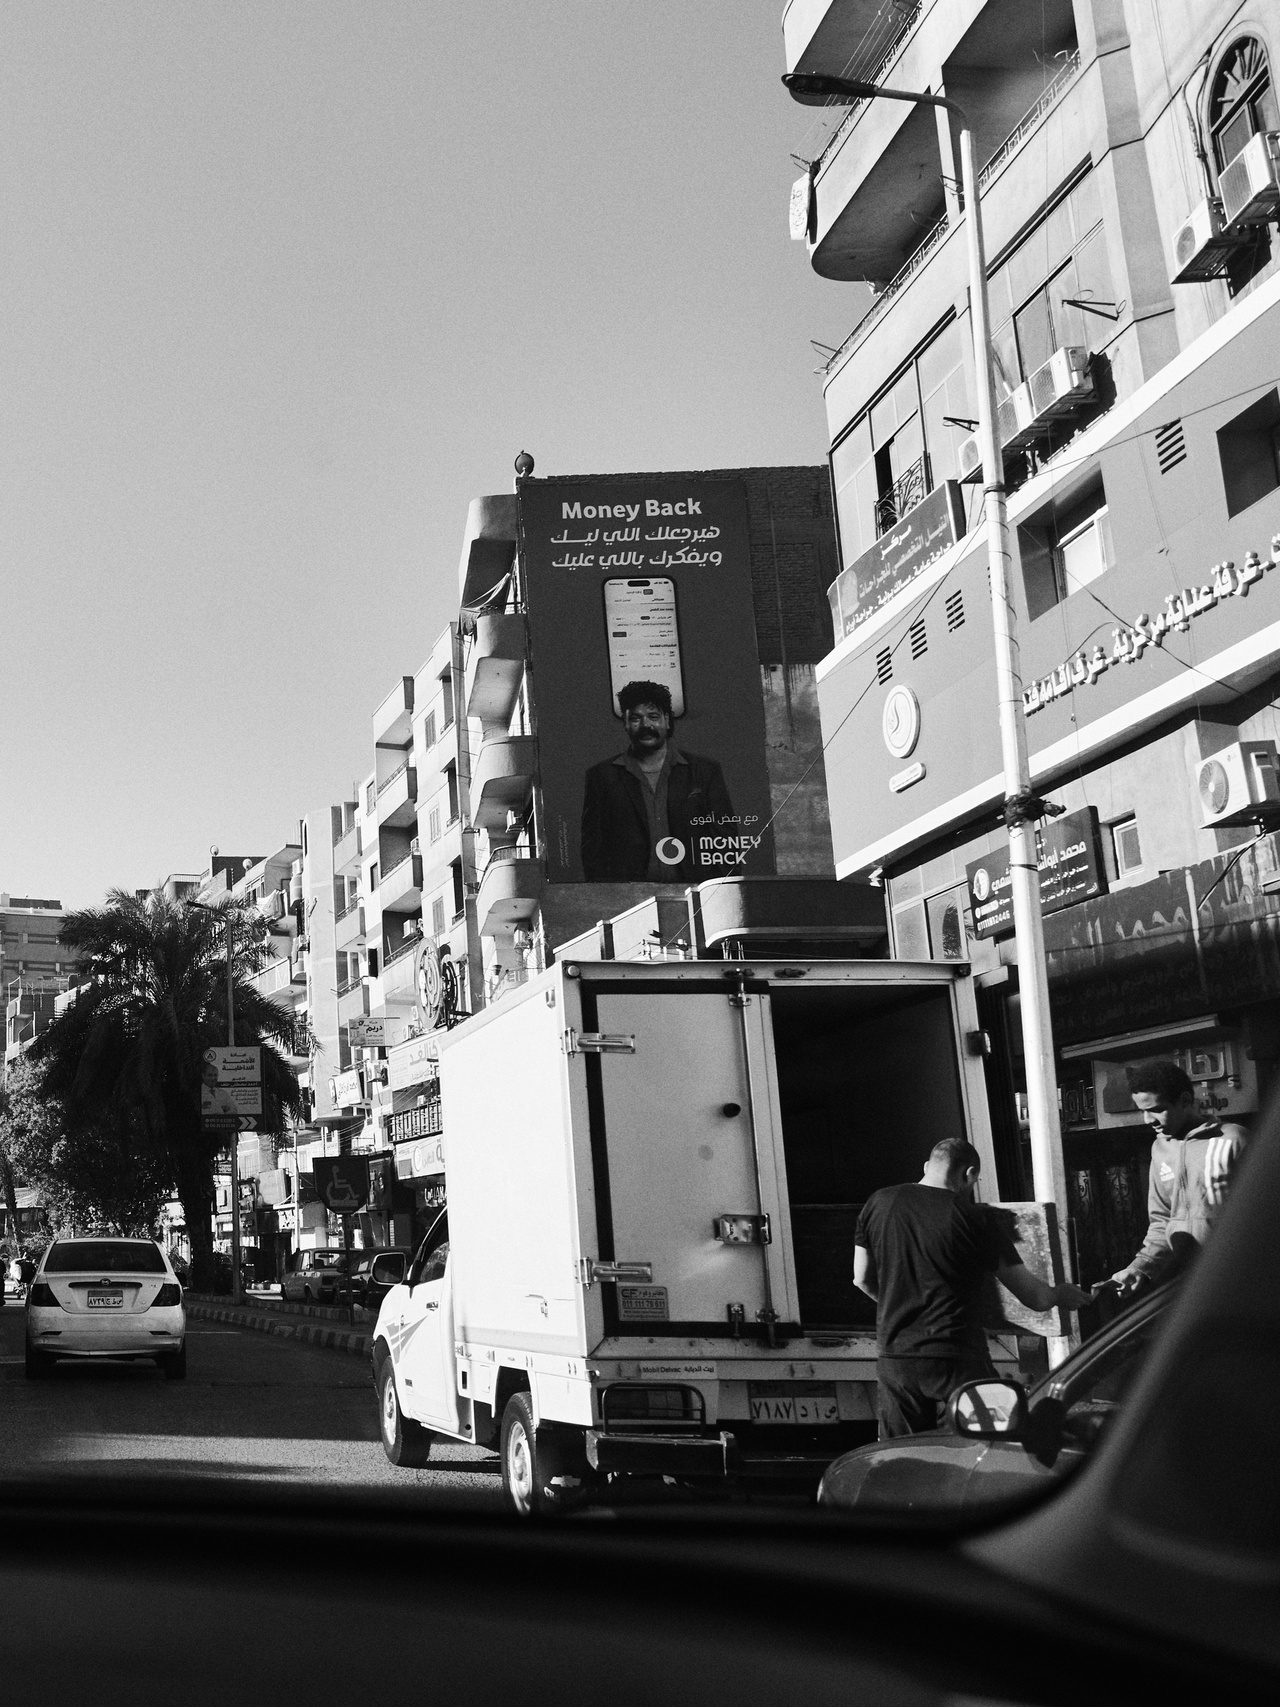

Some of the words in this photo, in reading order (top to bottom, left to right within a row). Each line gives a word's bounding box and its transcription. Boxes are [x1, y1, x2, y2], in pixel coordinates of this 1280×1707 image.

[561, 501, 641, 522] Money
[645, 497, 703, 517] Back
[602, 527, 641, 546] اللي
[644, 525, 721, 543] هيرجعلك
[551, 552, 595, 571] عليك
[598, 551, 645, 570] باللي
[648, 546, 723, 568] ويفكرك
[1210, 551, 1260, 599] غرفة
[1164, 585, 1216, 632] عناية
[1111, 613, 1167, 663] مركزية
[690, 811, 716, 825] أقوى
[717, 814, 741, 825] بعض
[743, 815, 759, 826] مع
[700, 836, 761, 850] MONEY
[1060, 840, 1088, 862] محمد
[700, 851, 747, 865] BACK
[752, 1401, 792, 1420] ٧١٨٧
